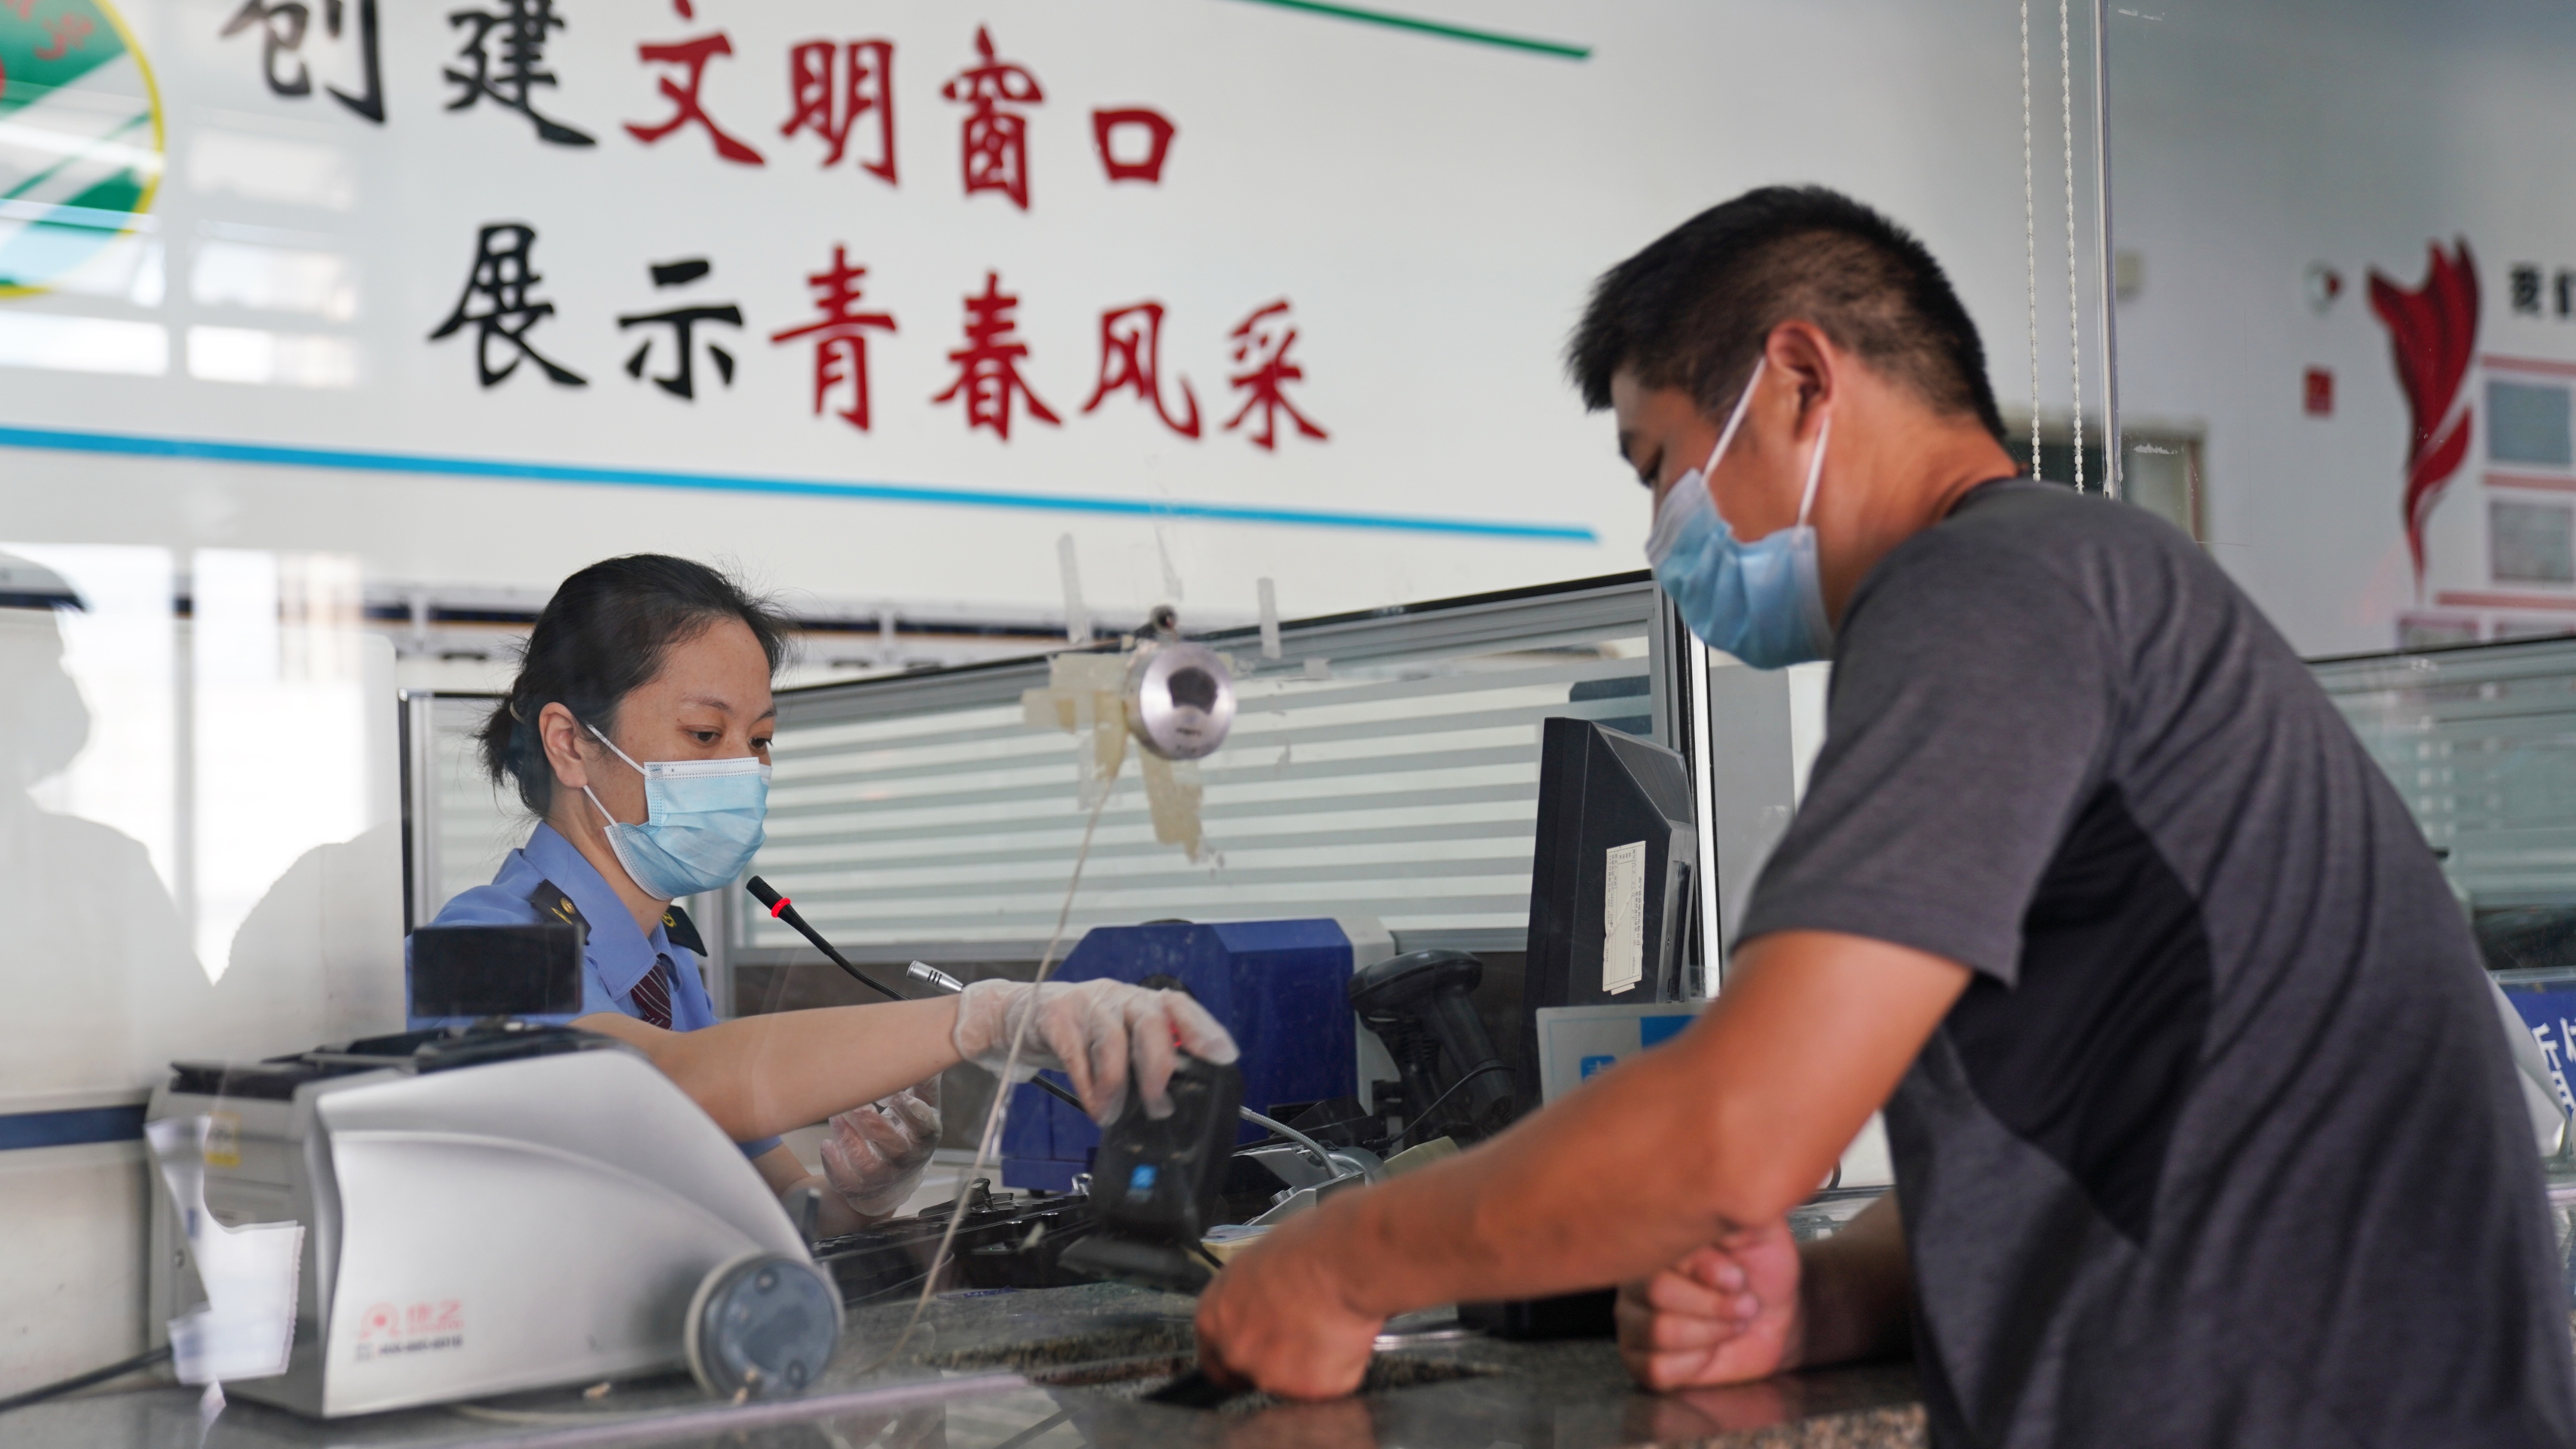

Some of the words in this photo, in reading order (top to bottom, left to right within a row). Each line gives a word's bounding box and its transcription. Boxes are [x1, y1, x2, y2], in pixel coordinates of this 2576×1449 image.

[221, 0, 1176, 210] 创建文明窗口
[428, 223, 1328, 450] 展示青春风采
